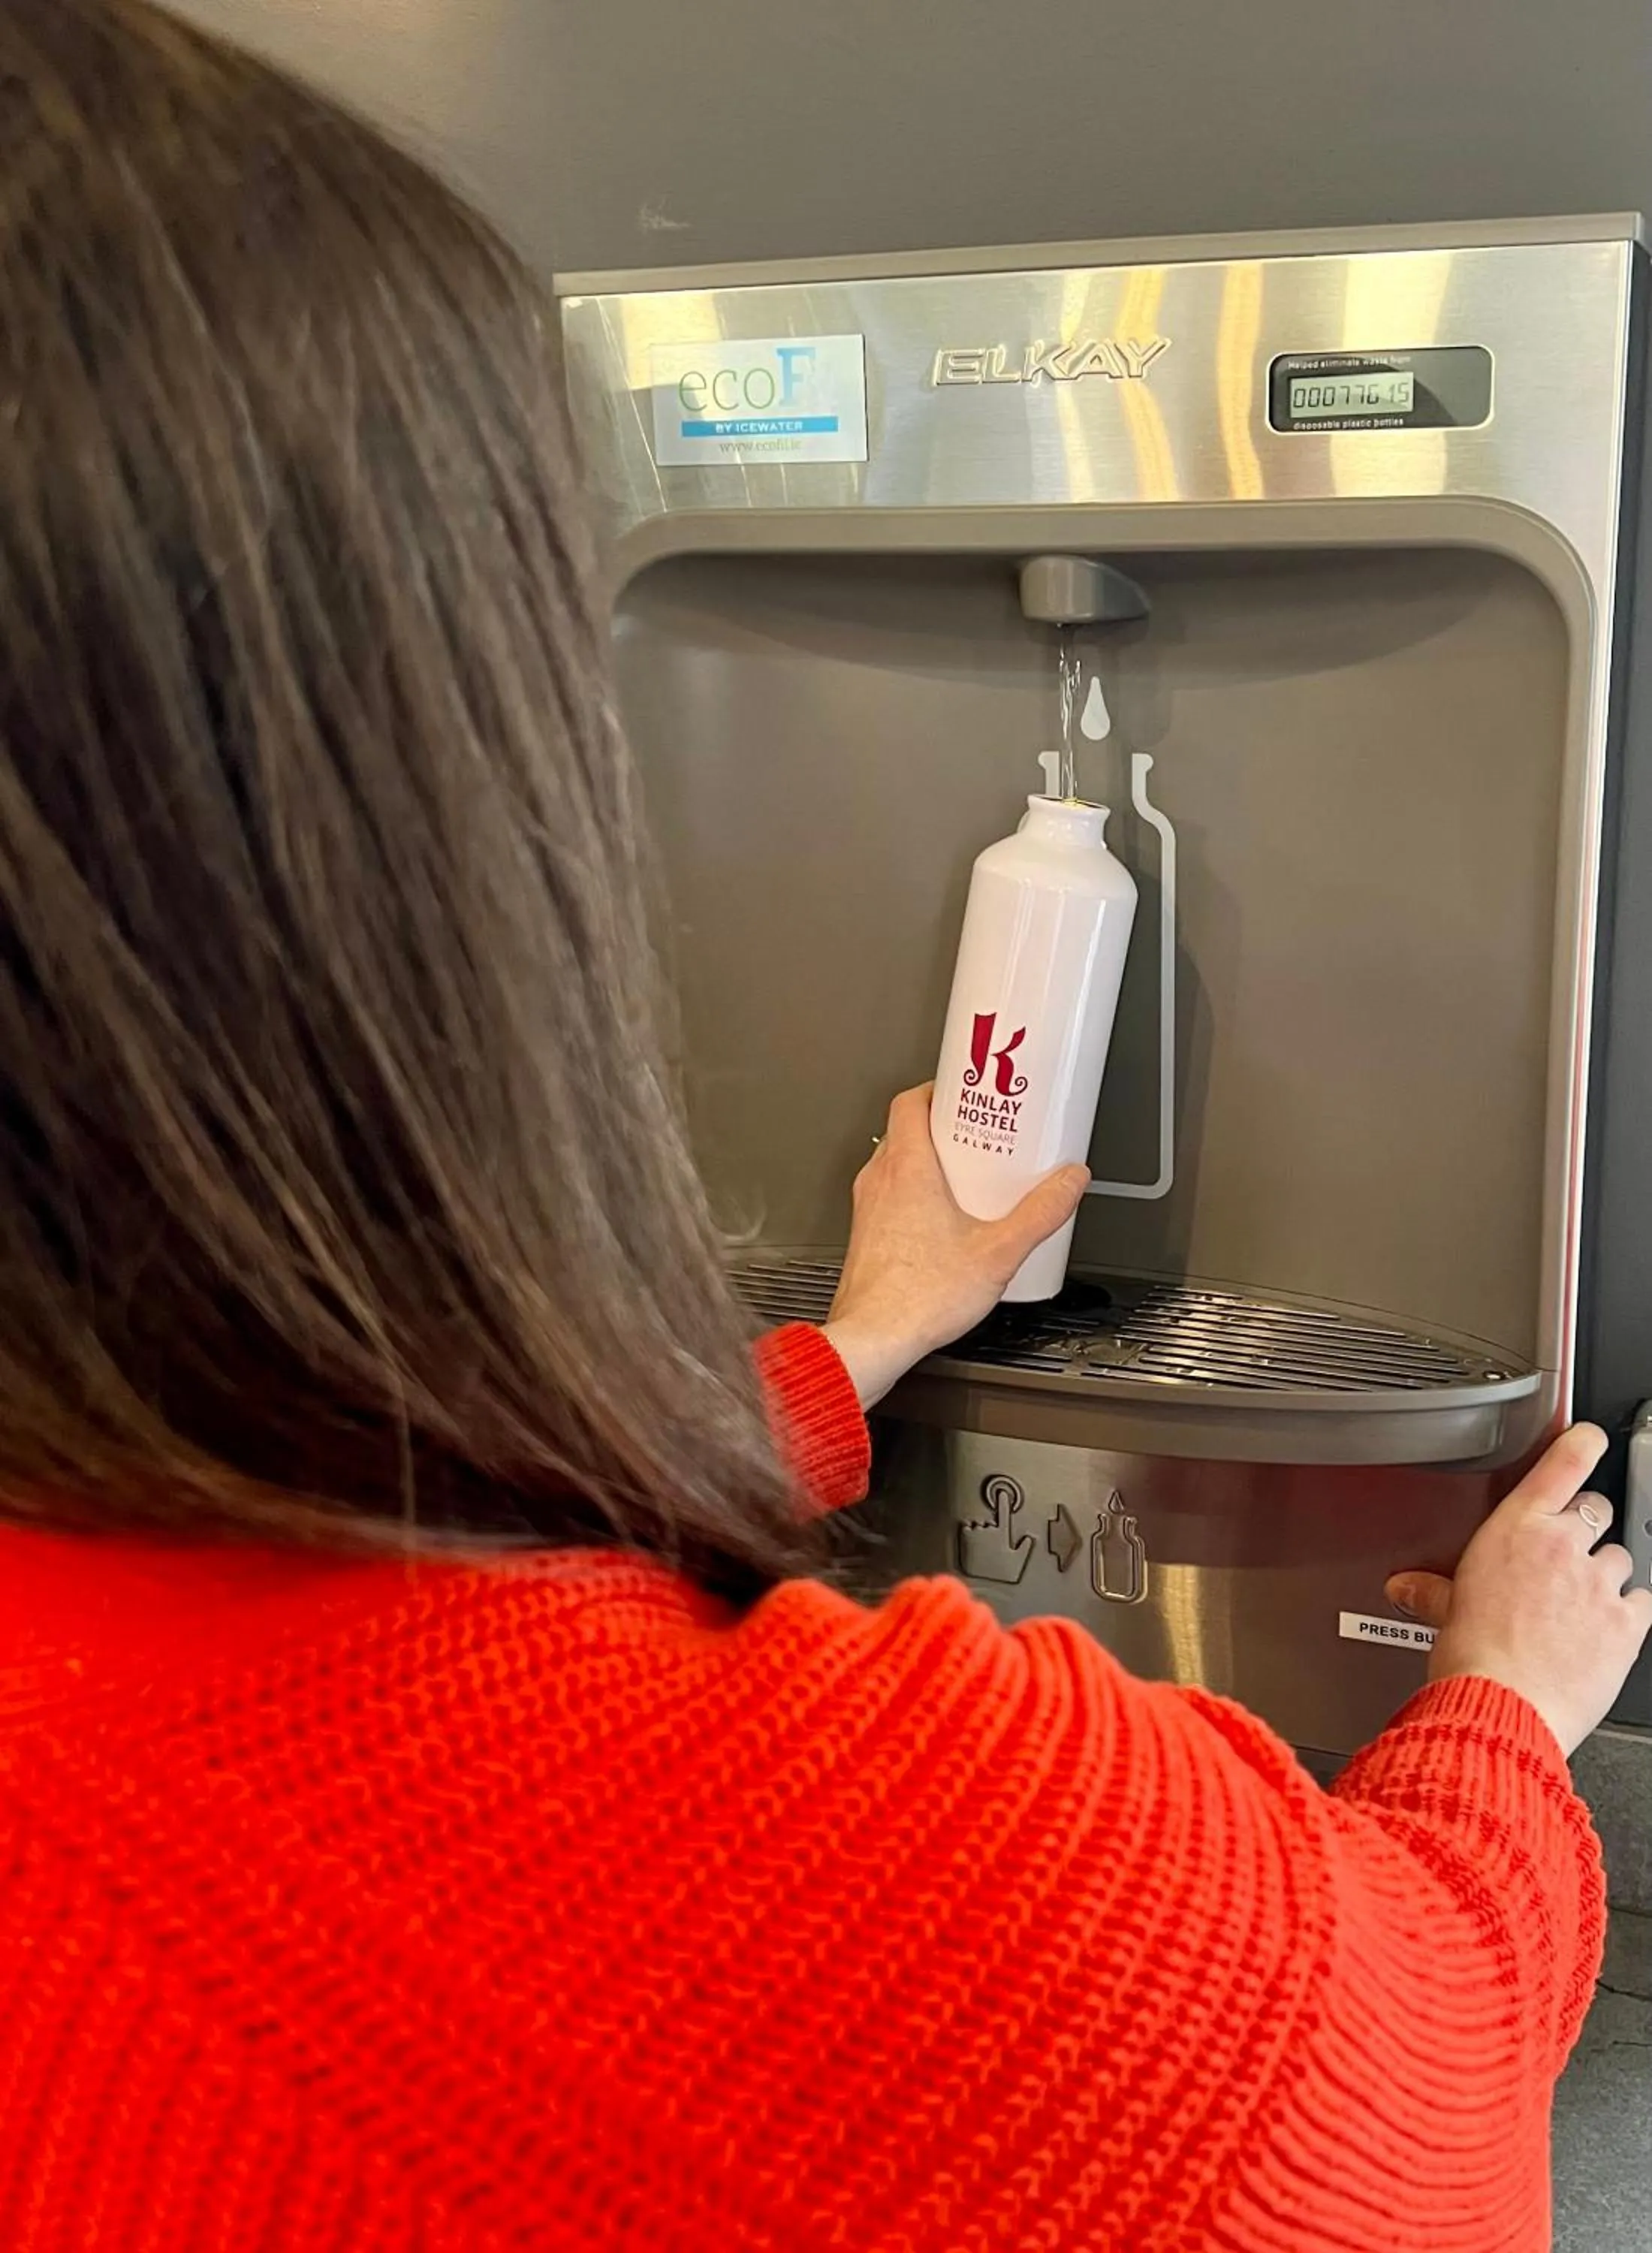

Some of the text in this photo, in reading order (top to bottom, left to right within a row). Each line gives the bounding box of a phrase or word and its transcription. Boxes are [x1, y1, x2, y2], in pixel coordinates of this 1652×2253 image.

[931, 336, 1171, 388] ELKAY
[1288, 360, 1319, 369] Helped
[1321, 357, 1360, 367] eliminate
[1364, 356, 1388, 366] waste
[716, 420, 803, 433] BY ICEWATER
[1293, 418, 1404, 430] disposable plastic bottles
[960, 1087, 1022, 1115] KINLAY
[957, 1105, 1017, 1133] HOSTEL
[953, 1133, 1014, 1157] GALWAY
[954, 1121, 1015, 1145] EYRE SQUARE
[1359, 1622, 1409, 1639] PRESS
